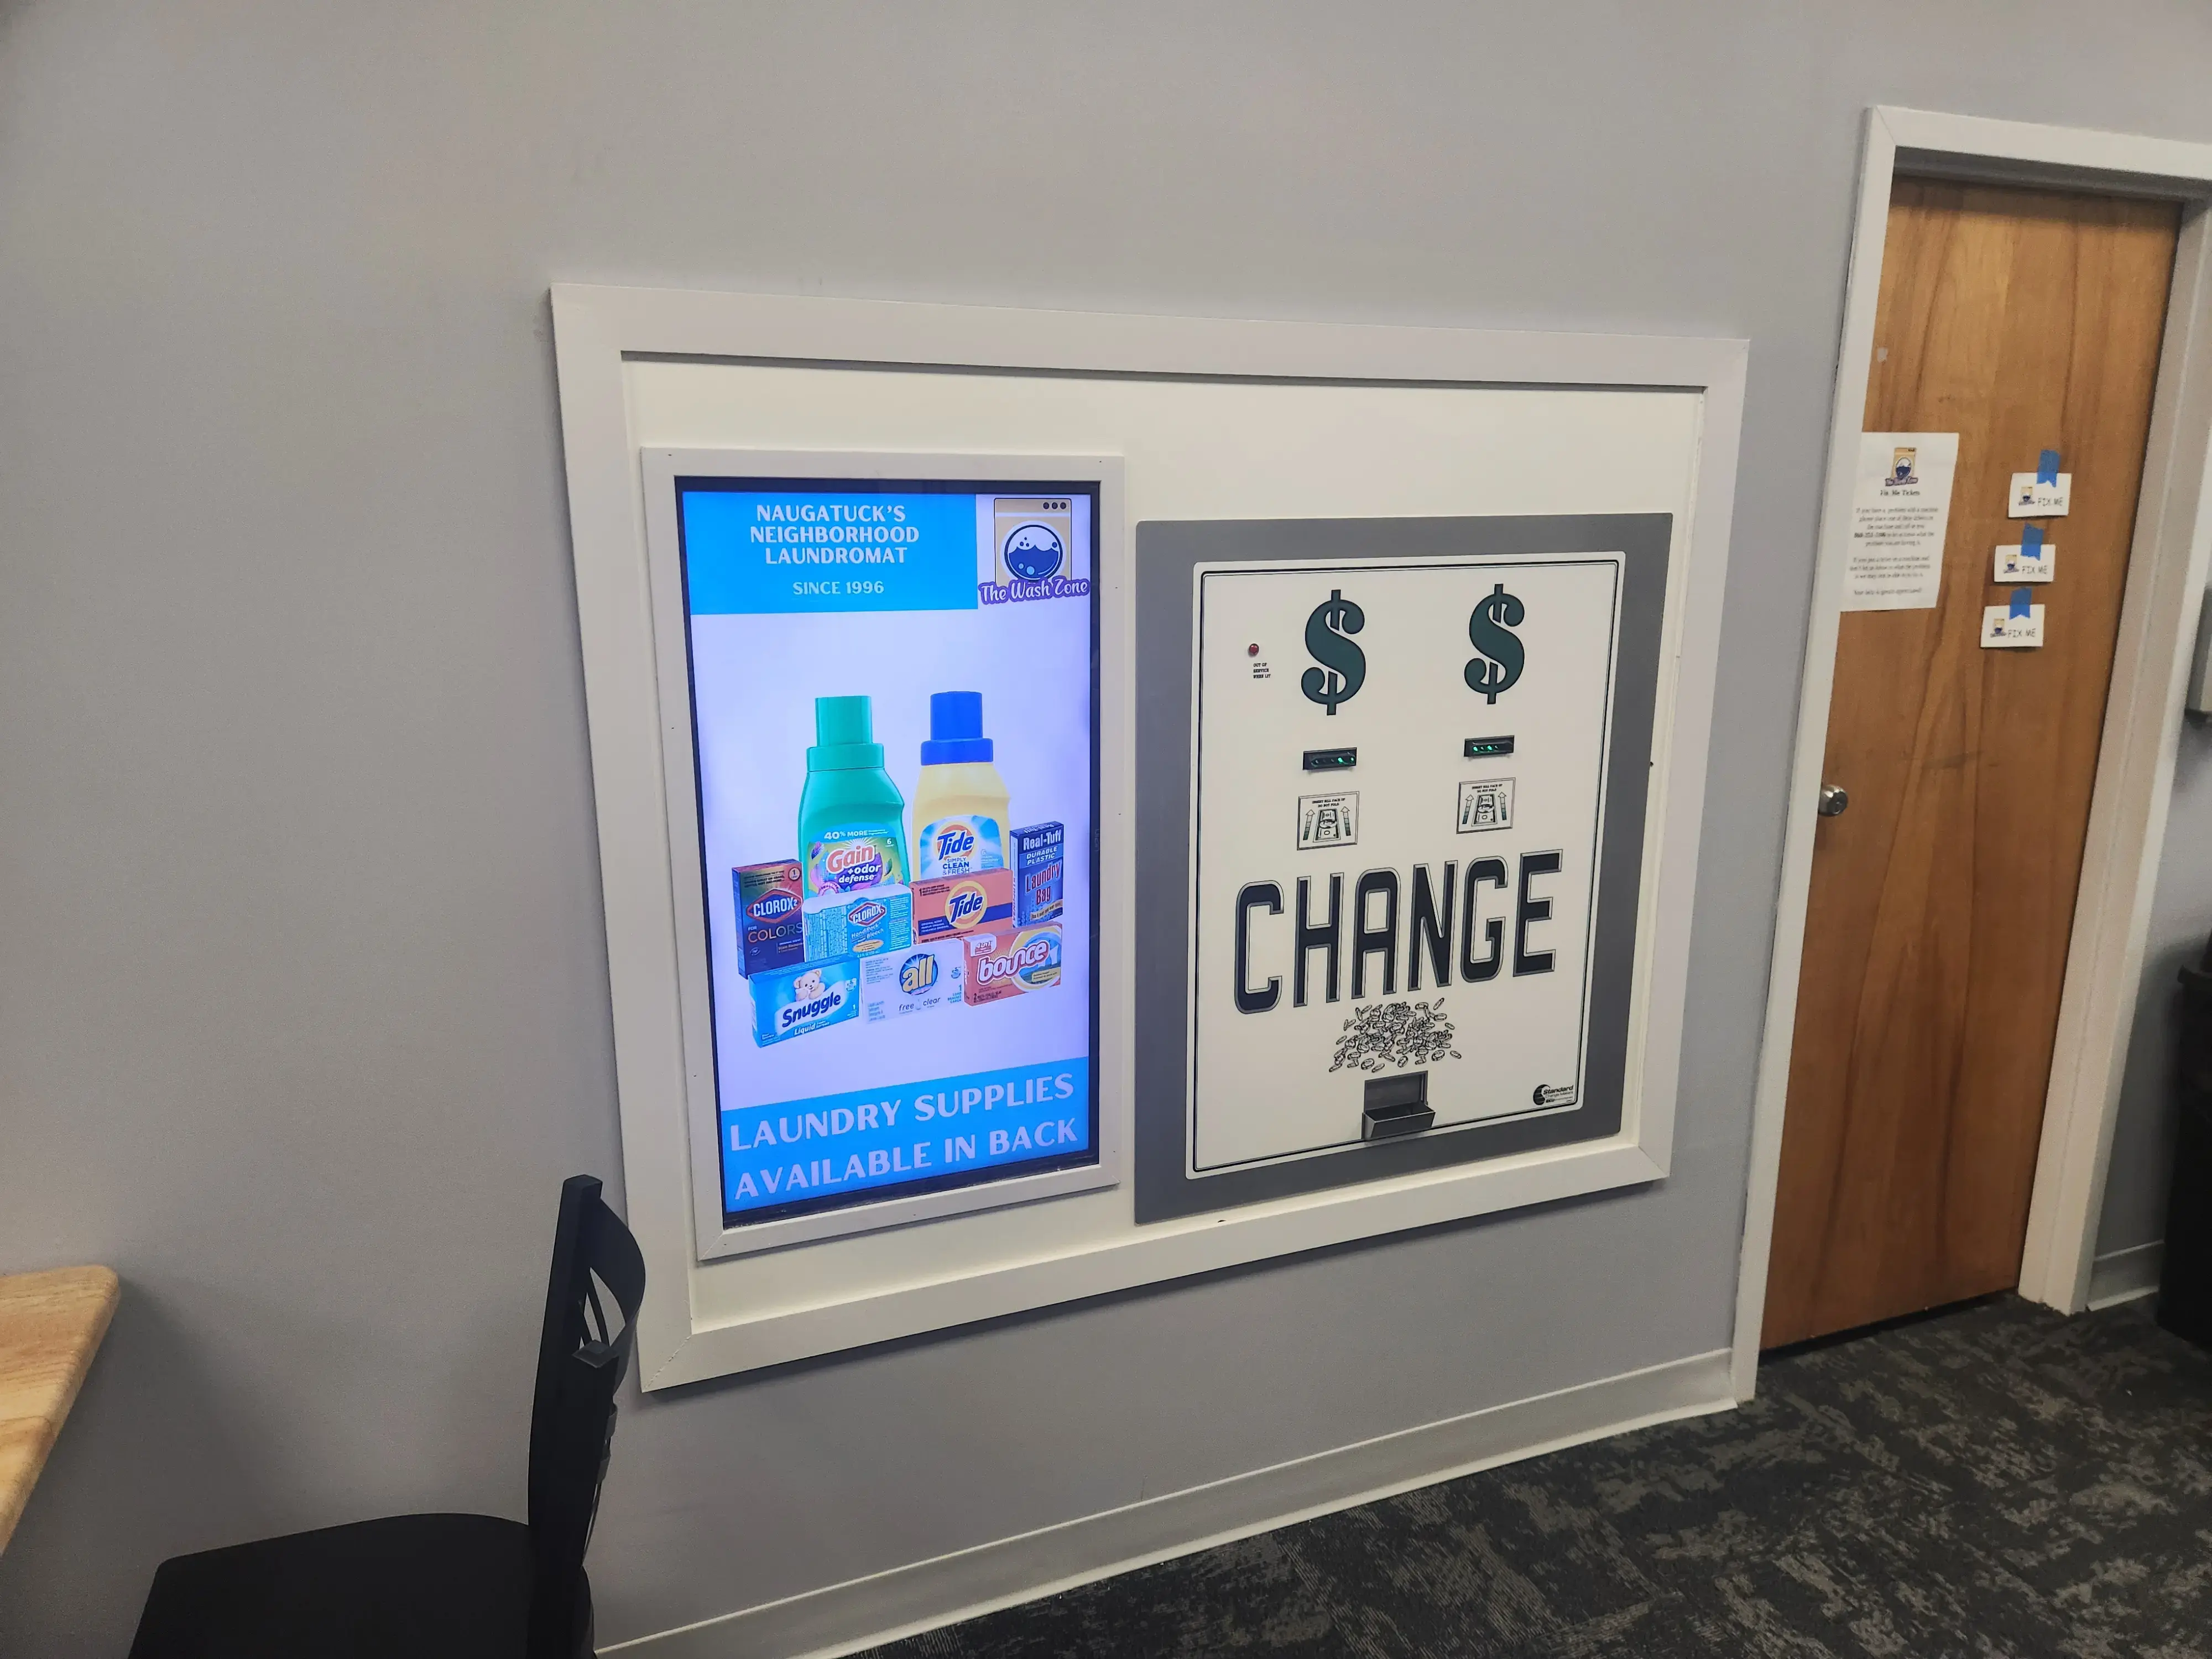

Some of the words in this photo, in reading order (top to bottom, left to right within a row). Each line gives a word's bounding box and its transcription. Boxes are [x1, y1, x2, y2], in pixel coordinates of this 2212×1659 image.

[2038, 497, 2052, 506] FIX
[2052, 497, 2063, 506] ME
[757, 504, 906, 523] NAUGATUCK'S
[750, 526, 920, 544] NEIGHBORHOOD
[765, 547, 908, 565] LAUNDROMAT
[2021, 565, 2036, 575] FIX
[2037, 565, 2048, 575] ME
[792, 581, 841, 596] SINCE
[846, 580, 885, 594] 1996
[981, 585, 1006, 602] The
[1010, 580, 1051, 599] Wash
[1054, 578, 1088, 596] Zone
[2007, 629, 2023, 638] FIX
[2025, 628, 2036, 638] ME
[823, 831, 846, 840] 40%
[1022, 830, 1062, 851] Real-Tuff
[937, 831, 974, 861] Tide
[1026, 846, 1058, 859] DURABLE
[827, 844, 874, 873] Gain
[942, 862, 969, 870] CLEAN
[1027, 853, 1056, 866] PLASTIC
[838, 874, 875, 884] defense
[1026, 861, 1061, 893] Laundry
[1036, 885, 1051, 905] Bag
[852, 904, 882, 924] CLOROX
[949, 891, 983, 924] Tide
[748, 922, 802, 943] COLORS
[1234, 848, 1564, 1015] CHANGE
[978, 941, 1048, 983] bounce
[901, 954, 935, 993] all
[781, 991, 842, 1029] Snuggle
[899, 1003, 914, 1011] free
[922, 997, 941, 1006] clear
[794, 1023, 816, 1036] Liquid
[1543, 1084, 1574, 1095] Standard
[730, 1099, 901, 1151] LAUNDRY
[914, 1073, 1074, 1121] SUPPLIES
[735, 1141, 932, 1200] AVAILABLE
[945, 1134, 975, 1164] IN
[989, 1117, 1078, 1155] BACK
